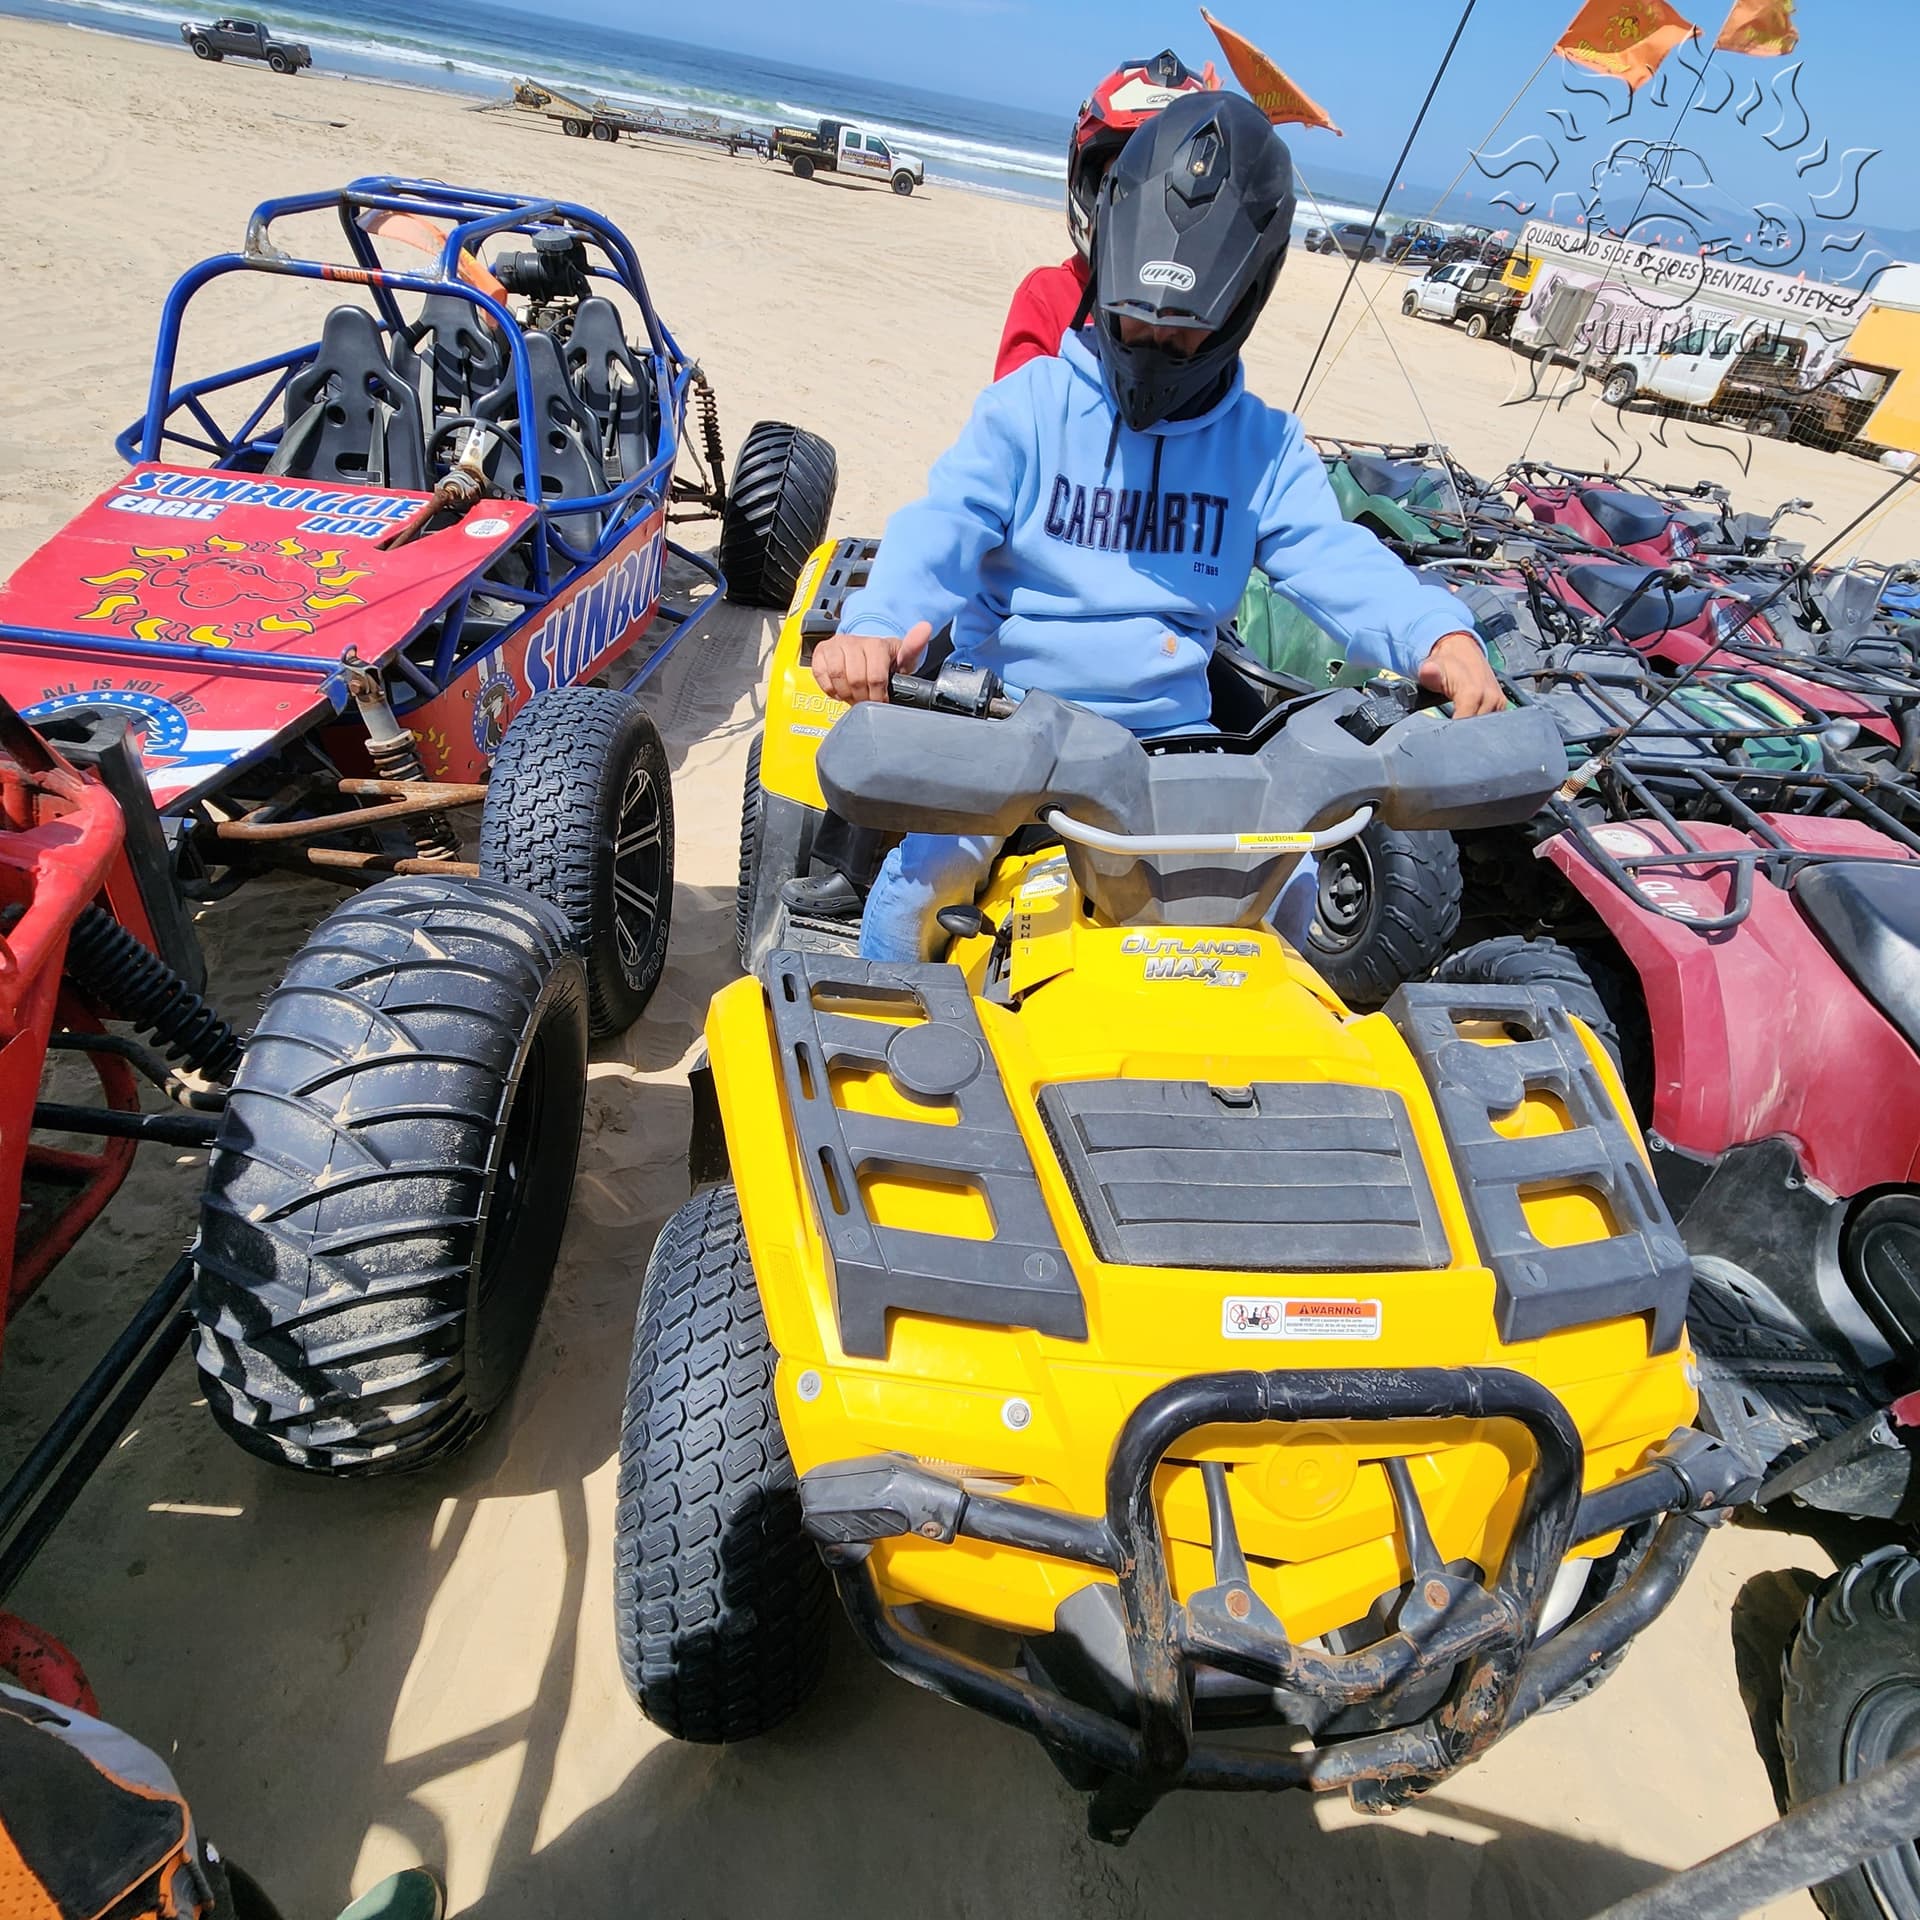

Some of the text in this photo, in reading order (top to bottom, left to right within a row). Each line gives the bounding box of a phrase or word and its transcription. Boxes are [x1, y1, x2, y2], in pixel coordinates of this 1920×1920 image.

[1527, 226, 1568, 252] QUADS
[1570, 238, 1600, 257] AND
[1600, 243, 1634, 265] SIDE
[1657, 256, 1700, 281] SIDES
[1702, 266, 1774, 298] RENTALS
[1782, 284, 1855, 318] STEVE'S
[107, 494, 226, 520] EAGLE
[120, 472, 428, 520] SUNBUGGIE
[297, 516, 396, 537] 404
[1044, 473, 1229, 558] CARHARTT
[524, 527, 662, 699] SUNBU
[41, 678, 207, 717] ALL IS NOT LOST
[1257, 835, 1294, 843] CAUTION
[1120, 935, 1261, 957] OUTLANDER
[1144, 956, 1249, 987] MAX XT
[1310, 1306, 1361, 1315] WARNING
